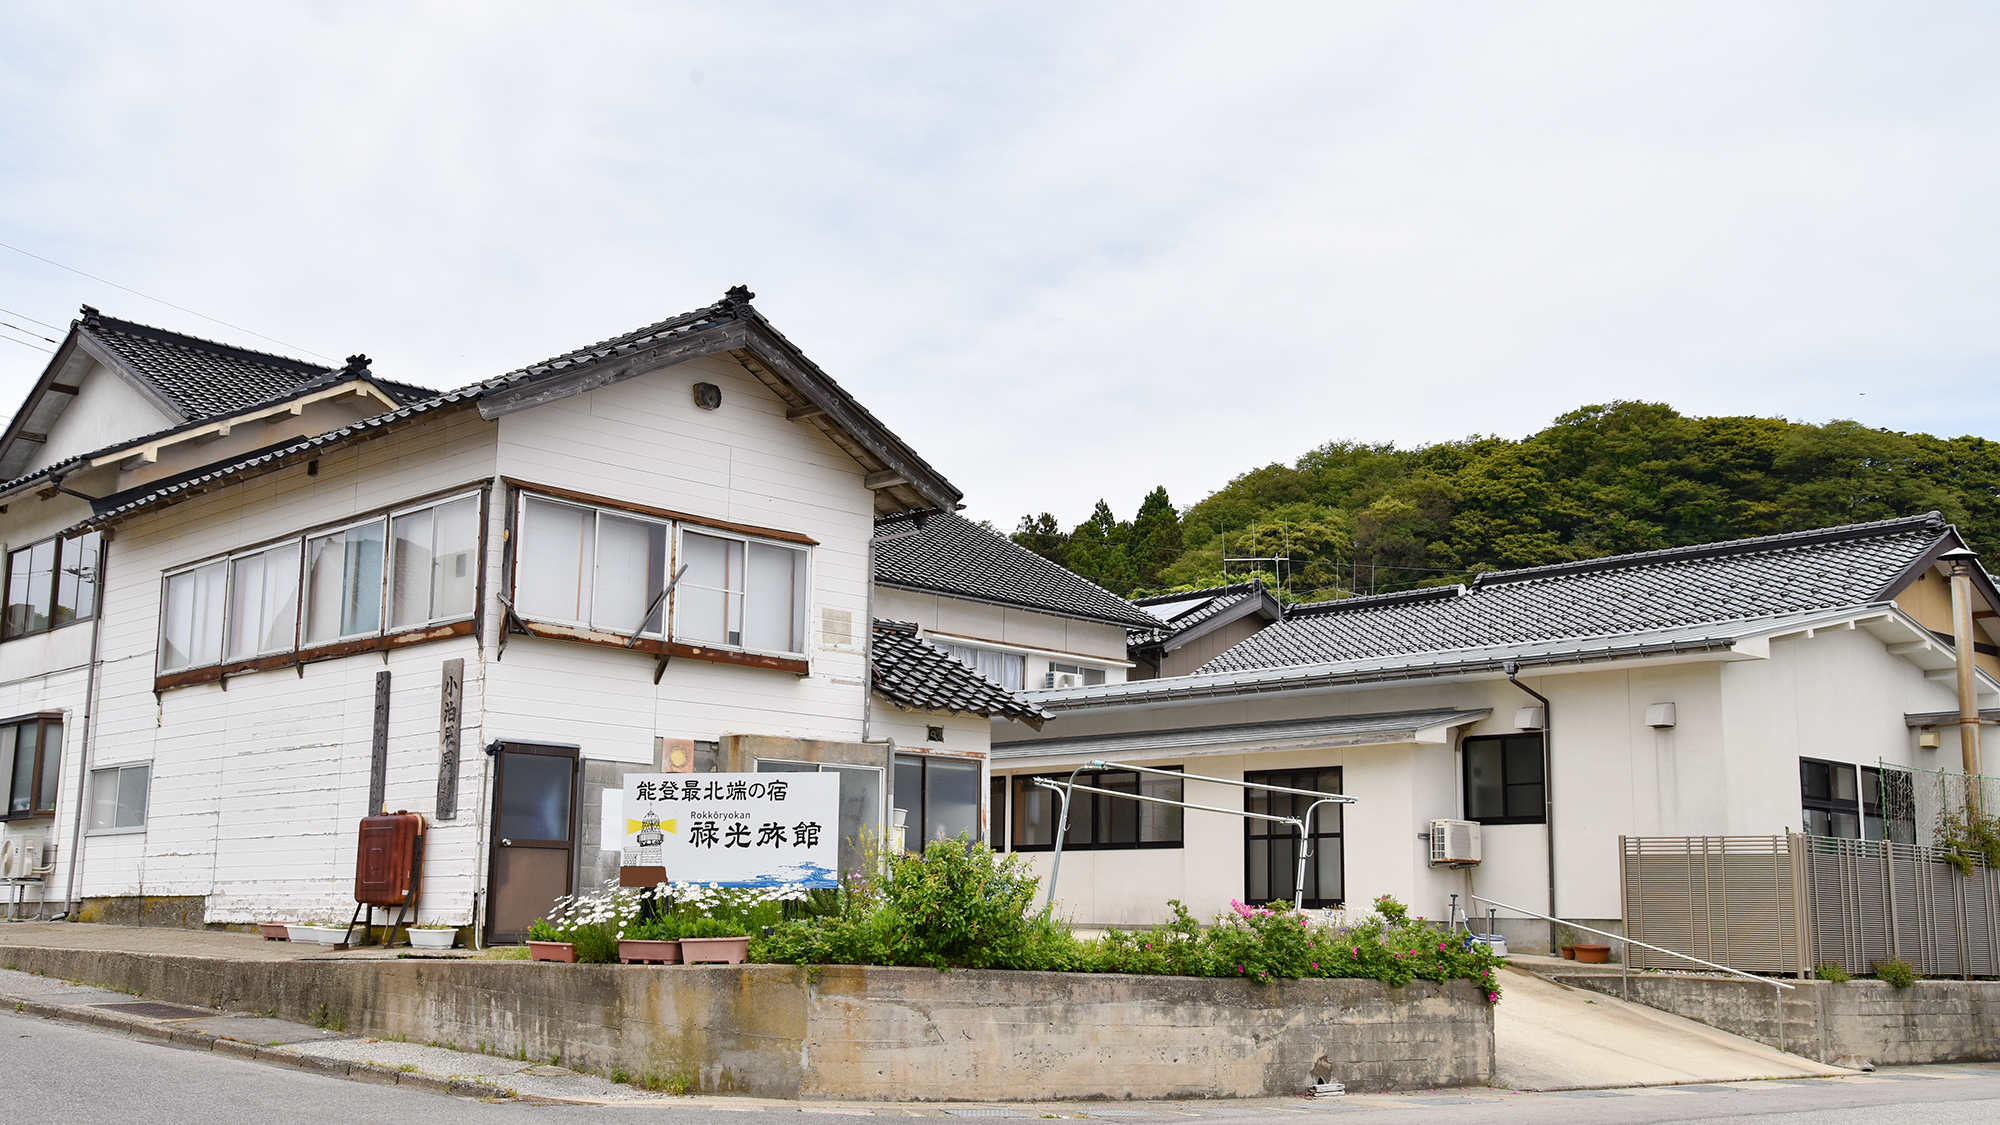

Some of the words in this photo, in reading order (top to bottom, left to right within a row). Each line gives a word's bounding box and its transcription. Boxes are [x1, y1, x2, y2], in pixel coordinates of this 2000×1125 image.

[636, 779, 789, 802] 能登最北端の宿
[690, 811, 751, 821] Rokkōryokan
[688, 821, 823, 849] 禄光旅館
